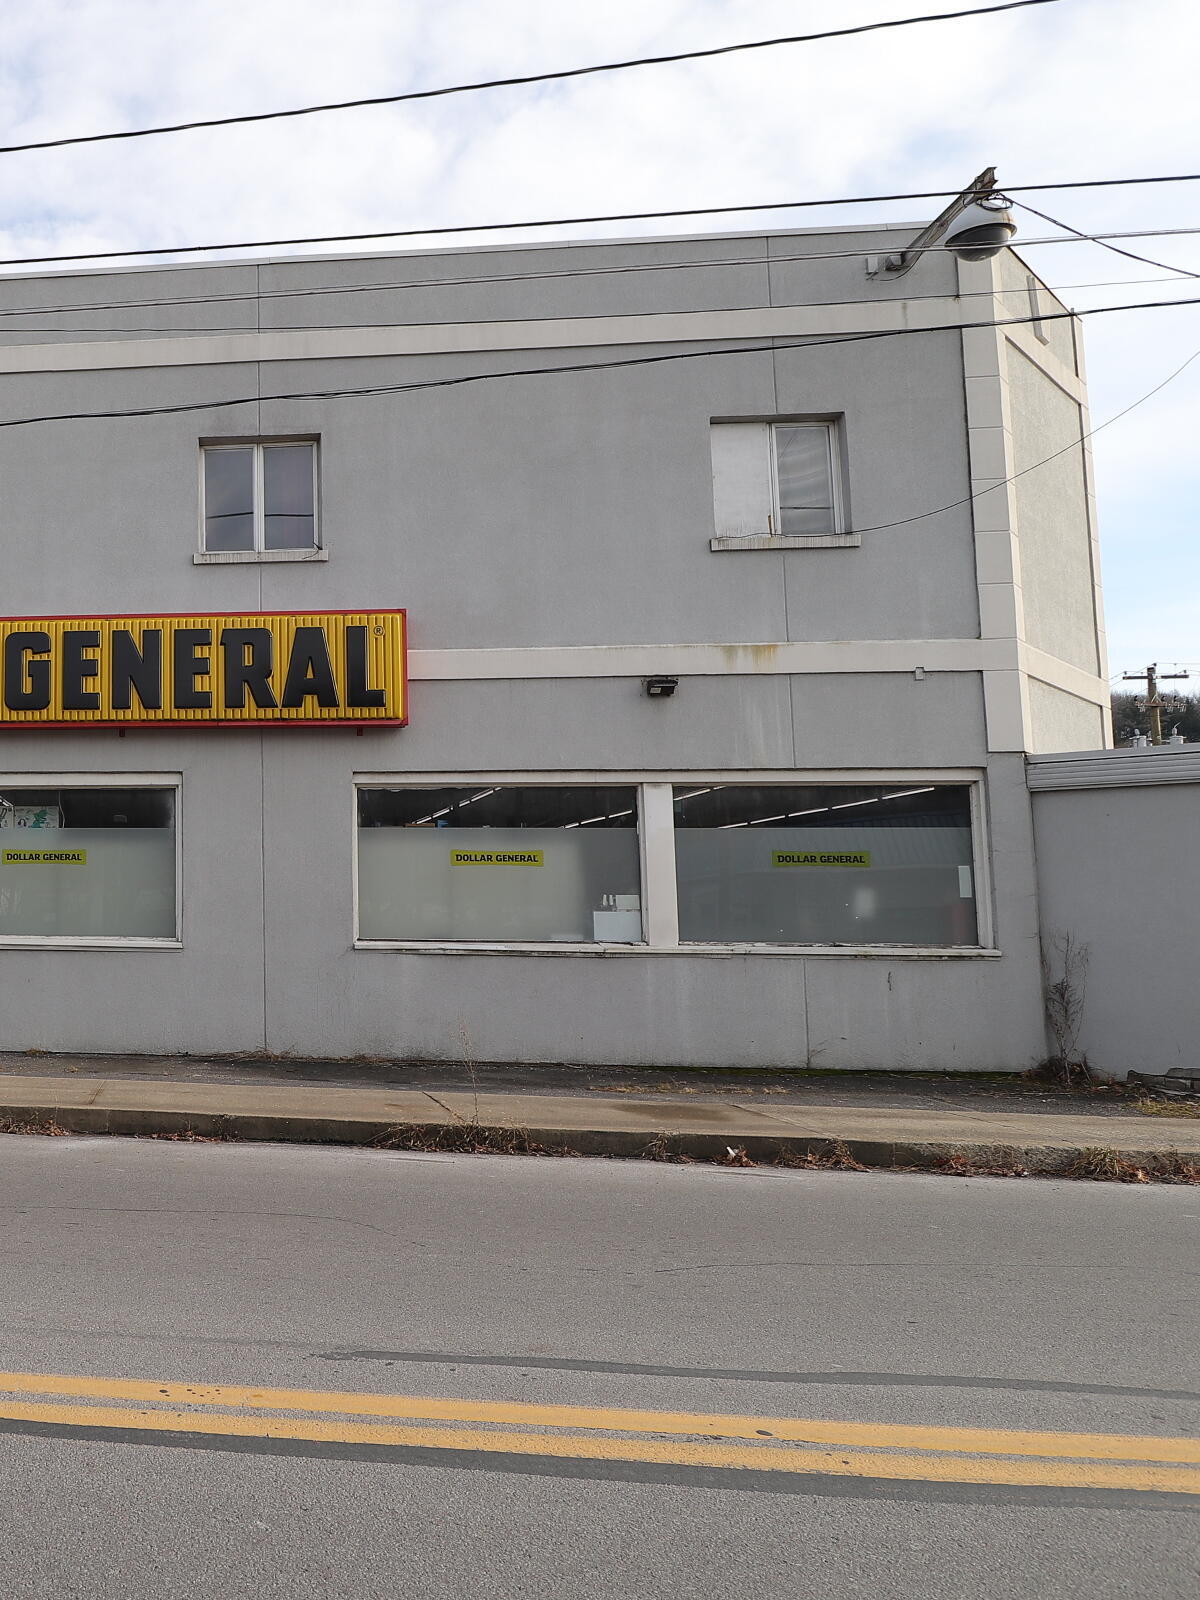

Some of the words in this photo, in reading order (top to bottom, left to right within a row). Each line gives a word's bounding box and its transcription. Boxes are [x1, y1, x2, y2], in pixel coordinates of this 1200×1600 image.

[6, 853, 41, 861] DOLLAR
[42, 853, 83, 861] GENERAL
[455, 854, 493, 862] DOLLAR
[495, 854, 539, 863] GENERAL
[777, 854, 817, 863] DOLLAR
[819, 854, 866, 864] GENERAL
